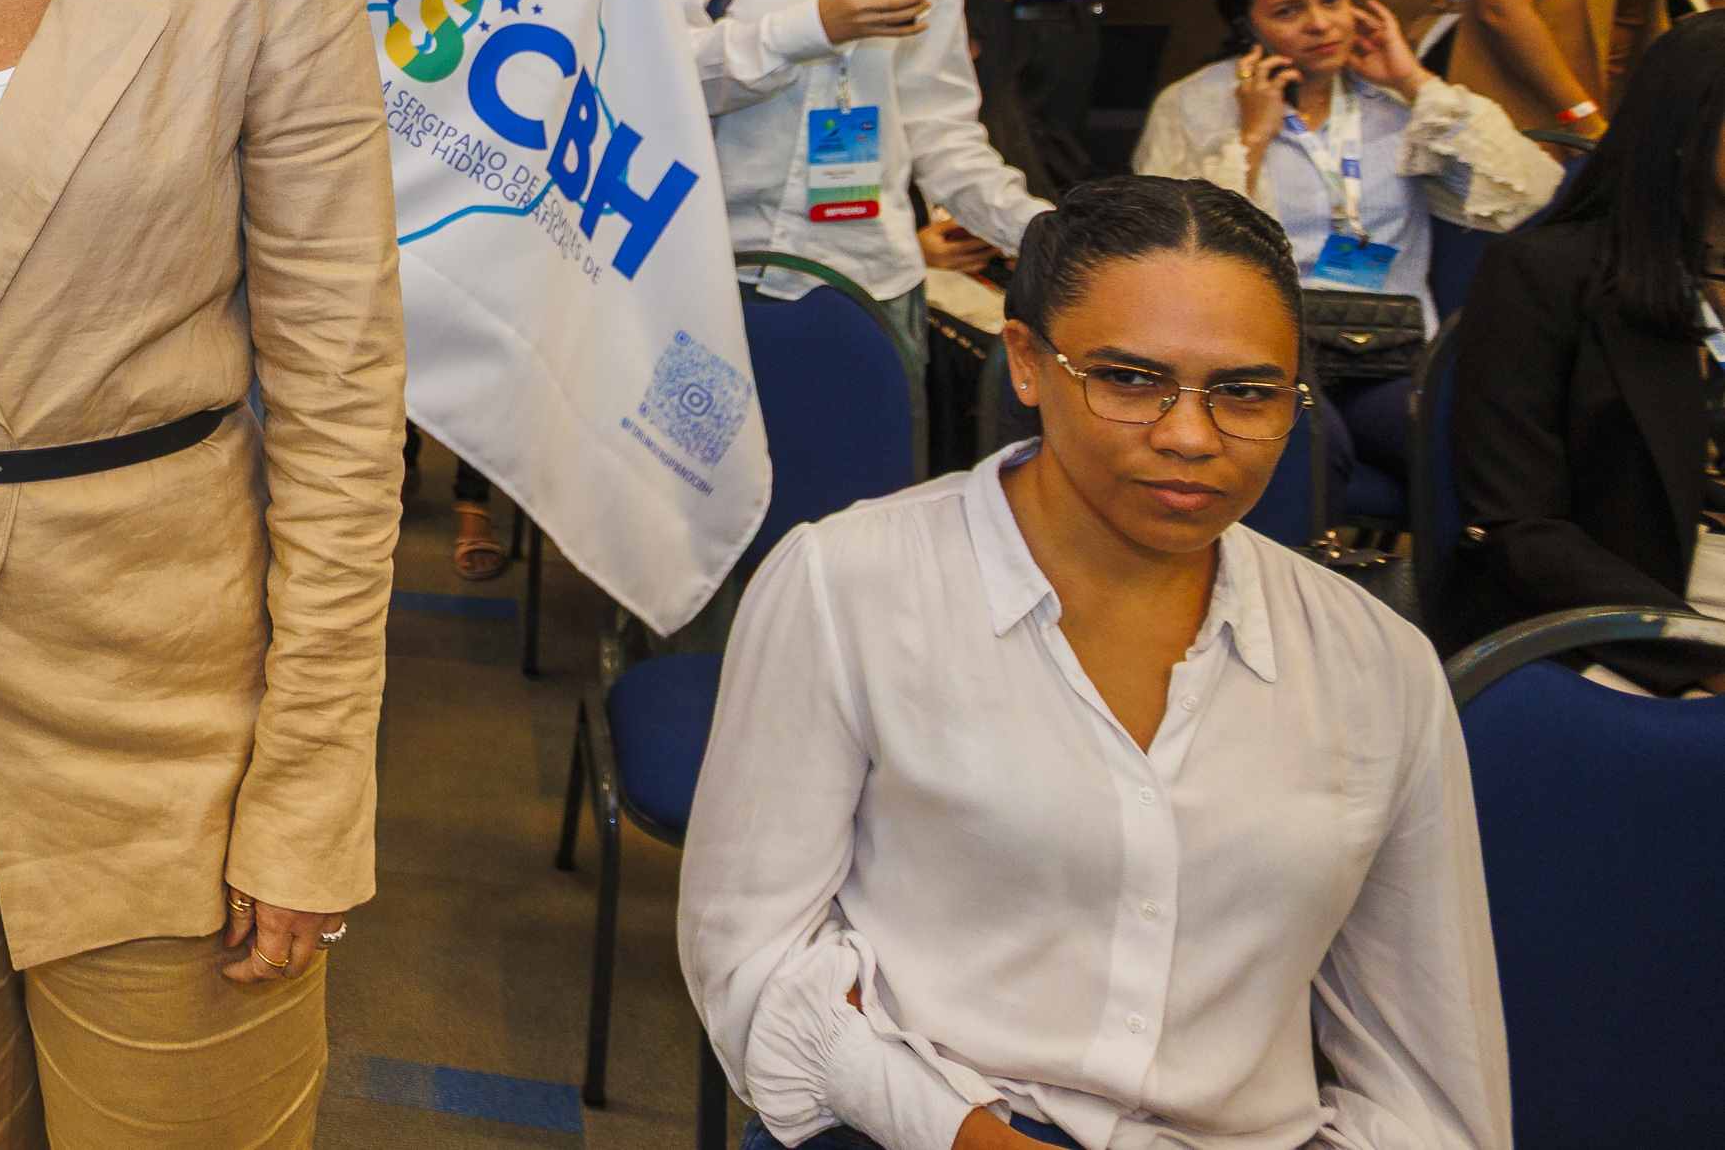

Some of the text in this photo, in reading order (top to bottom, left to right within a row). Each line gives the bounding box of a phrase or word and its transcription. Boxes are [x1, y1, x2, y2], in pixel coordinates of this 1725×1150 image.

[393, 90, 507, 171] SERGIPANO
[513, 165, 540, 195] DE
[583, 256, 602, 285] DE
